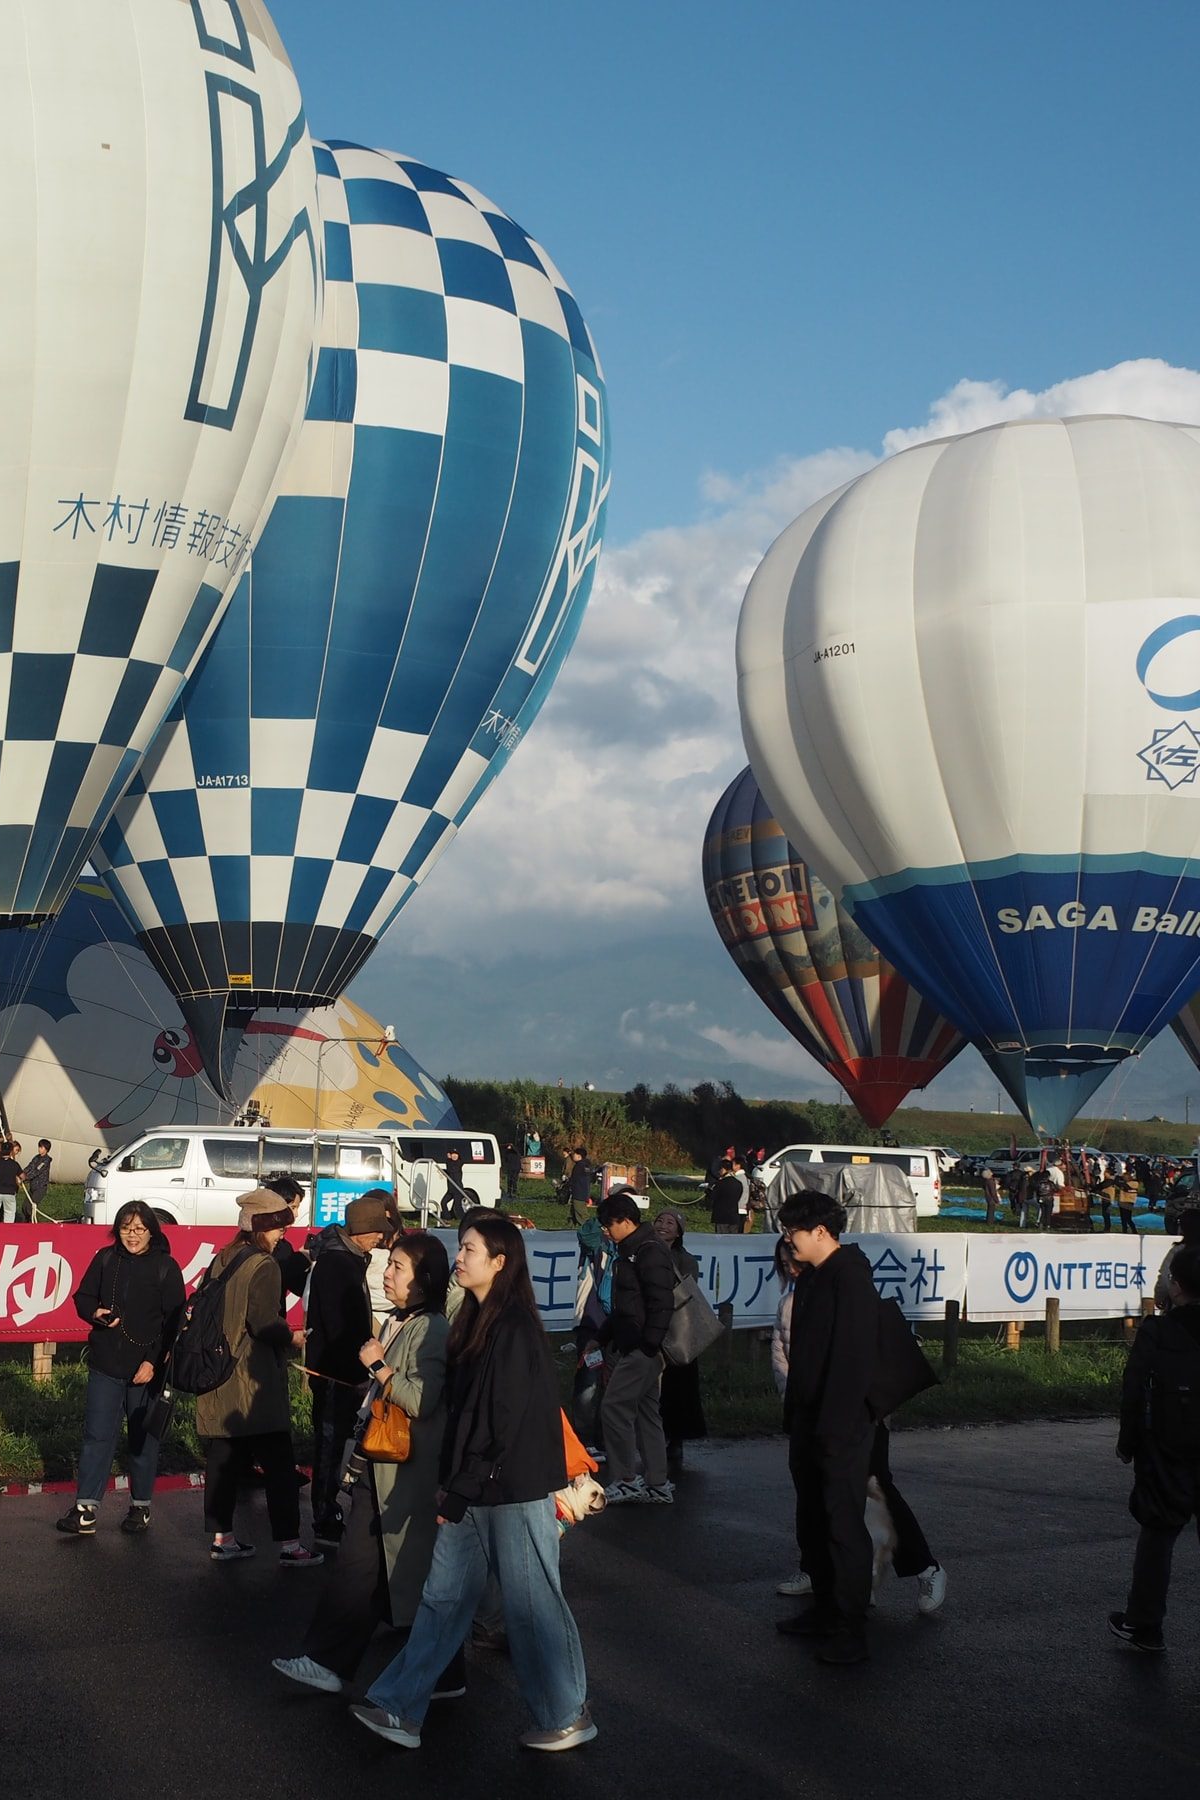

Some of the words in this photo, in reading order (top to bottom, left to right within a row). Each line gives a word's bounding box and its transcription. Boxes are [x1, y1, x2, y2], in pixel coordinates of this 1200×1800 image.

[813, 642, 856, 664] JA-A1201
[197, 774, 249, 787] JA-A1713
[997, 902, 1118, 934] SAGA
[1131, 906, 1200, 938] Ball
